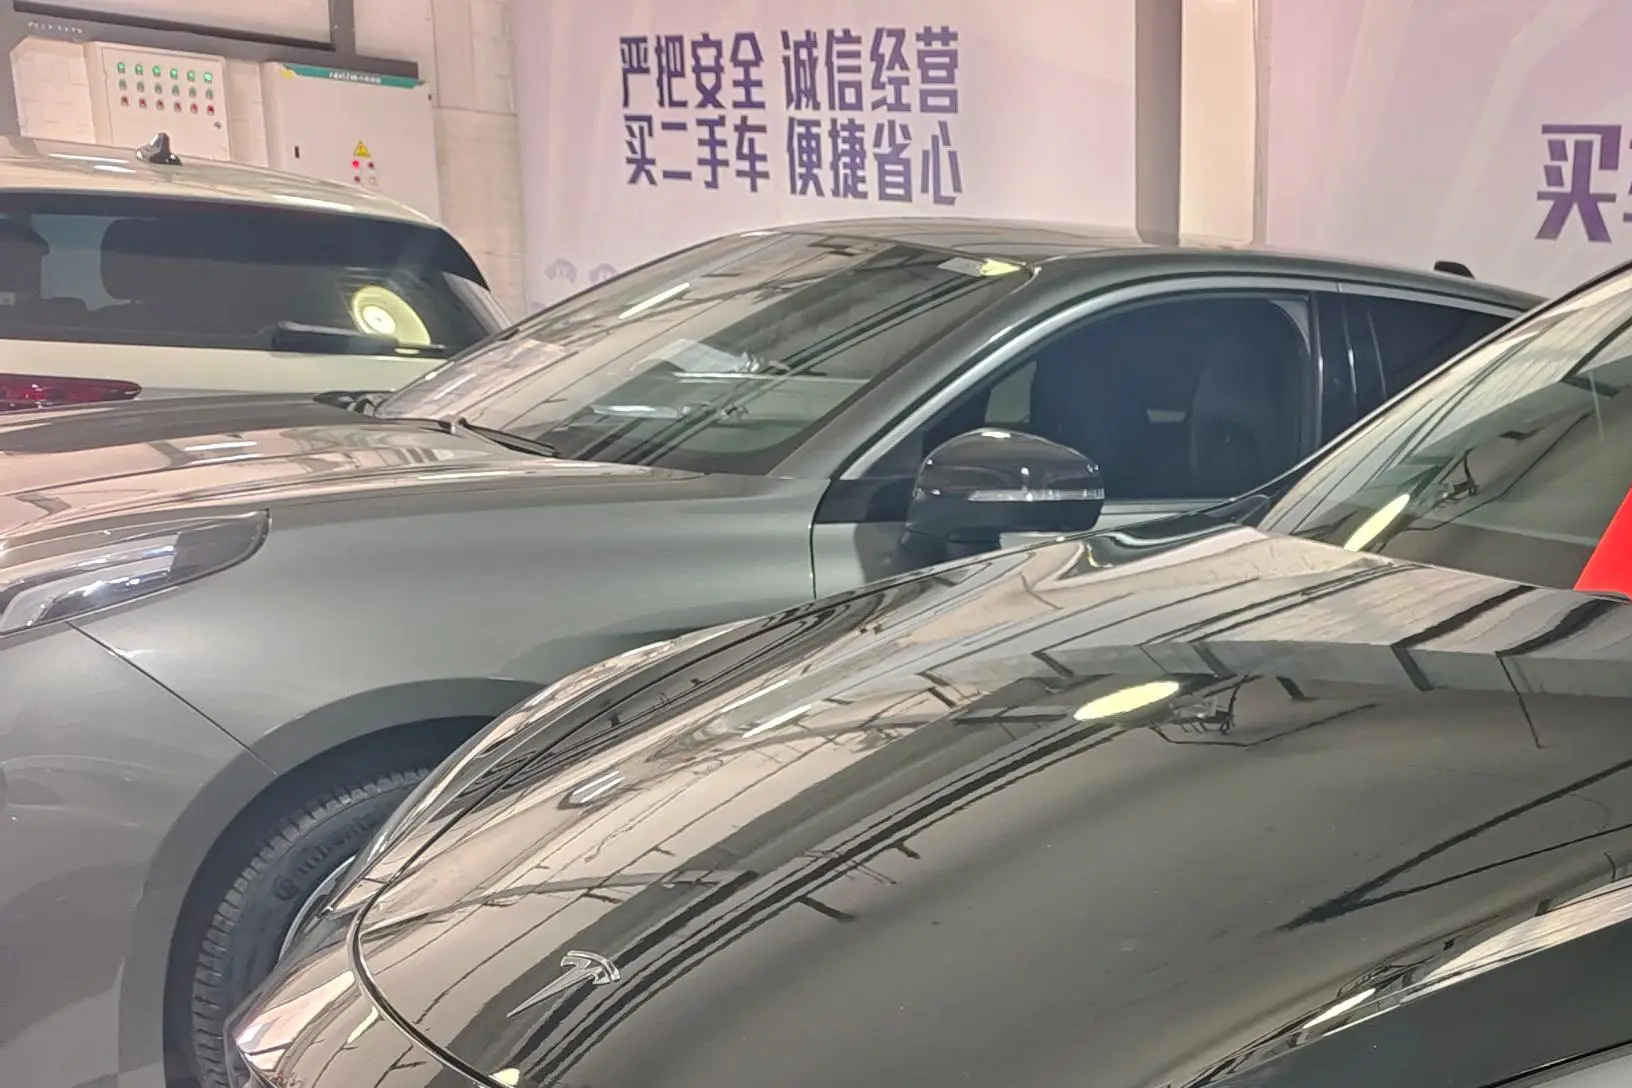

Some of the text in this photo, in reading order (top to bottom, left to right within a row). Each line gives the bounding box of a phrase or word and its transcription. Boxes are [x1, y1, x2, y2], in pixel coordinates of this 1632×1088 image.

[619, 25, 959, 114] 严把安全 诚信经营
[624, 114, 963, 206] 买二手车 便捷省心
